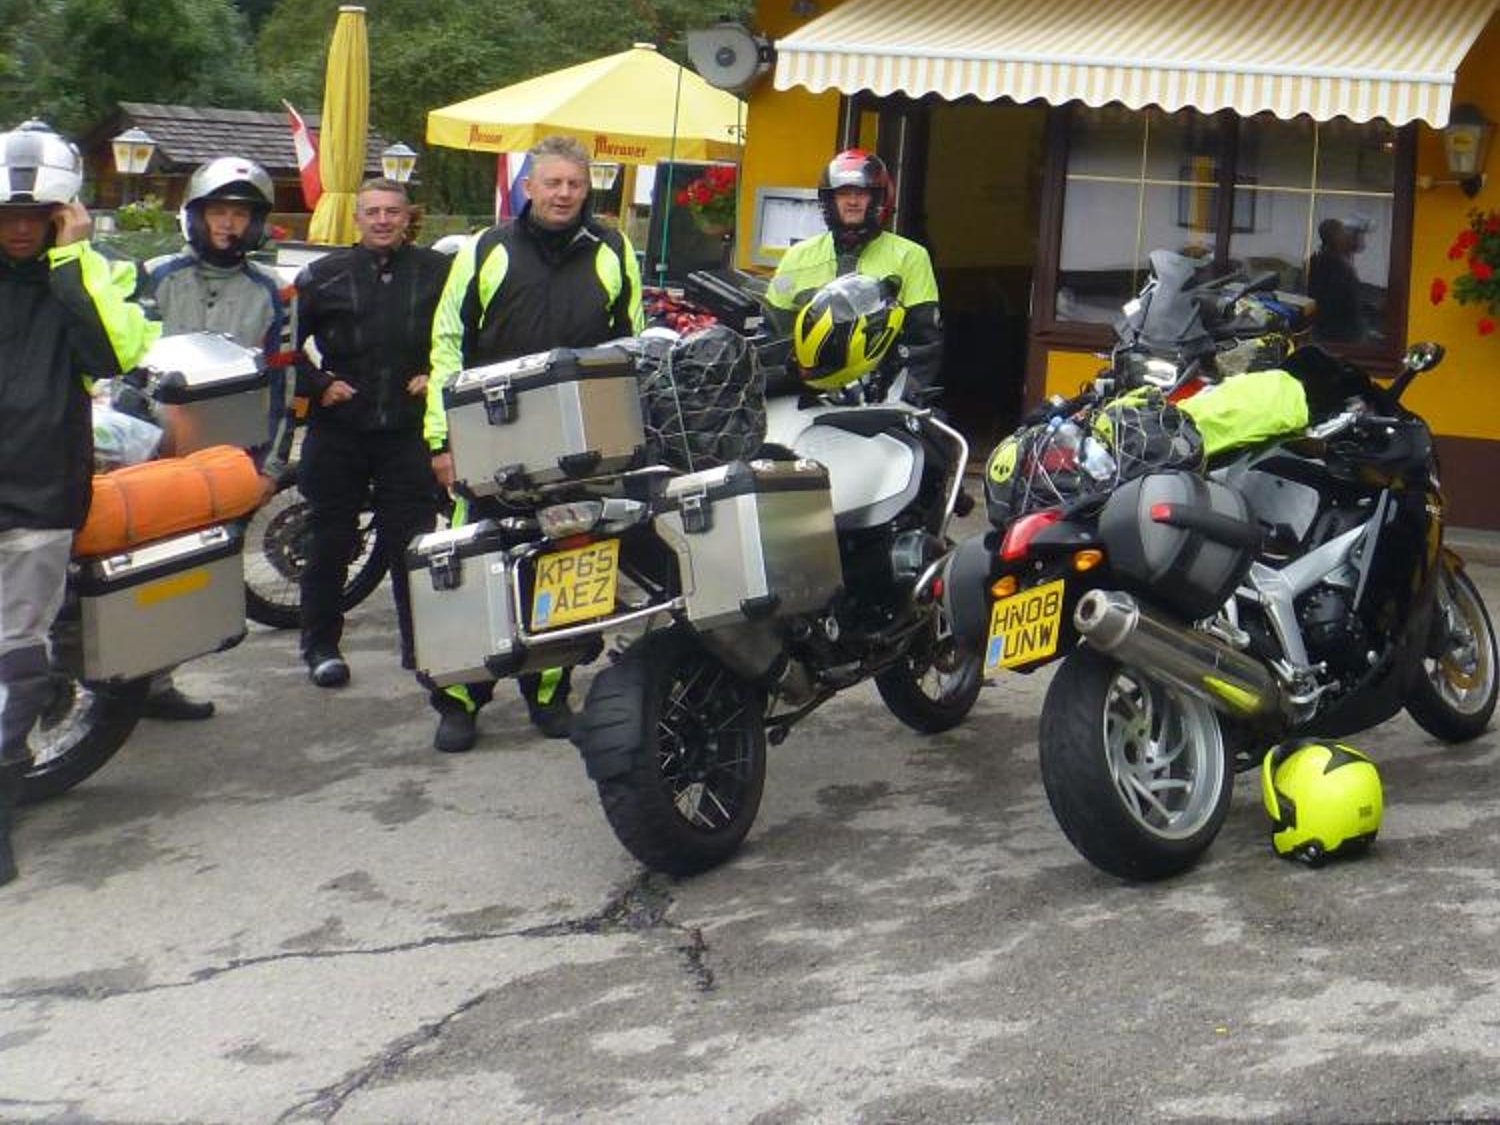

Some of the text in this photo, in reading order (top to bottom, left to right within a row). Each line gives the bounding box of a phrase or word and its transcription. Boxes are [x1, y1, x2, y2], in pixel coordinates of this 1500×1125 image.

[539, 546, 613, 587] KP65
[554, 576, 611, 613] AEZ
[993, 591, 1059, 635] HN08
[1003, 620, 1054, 659] UNW
